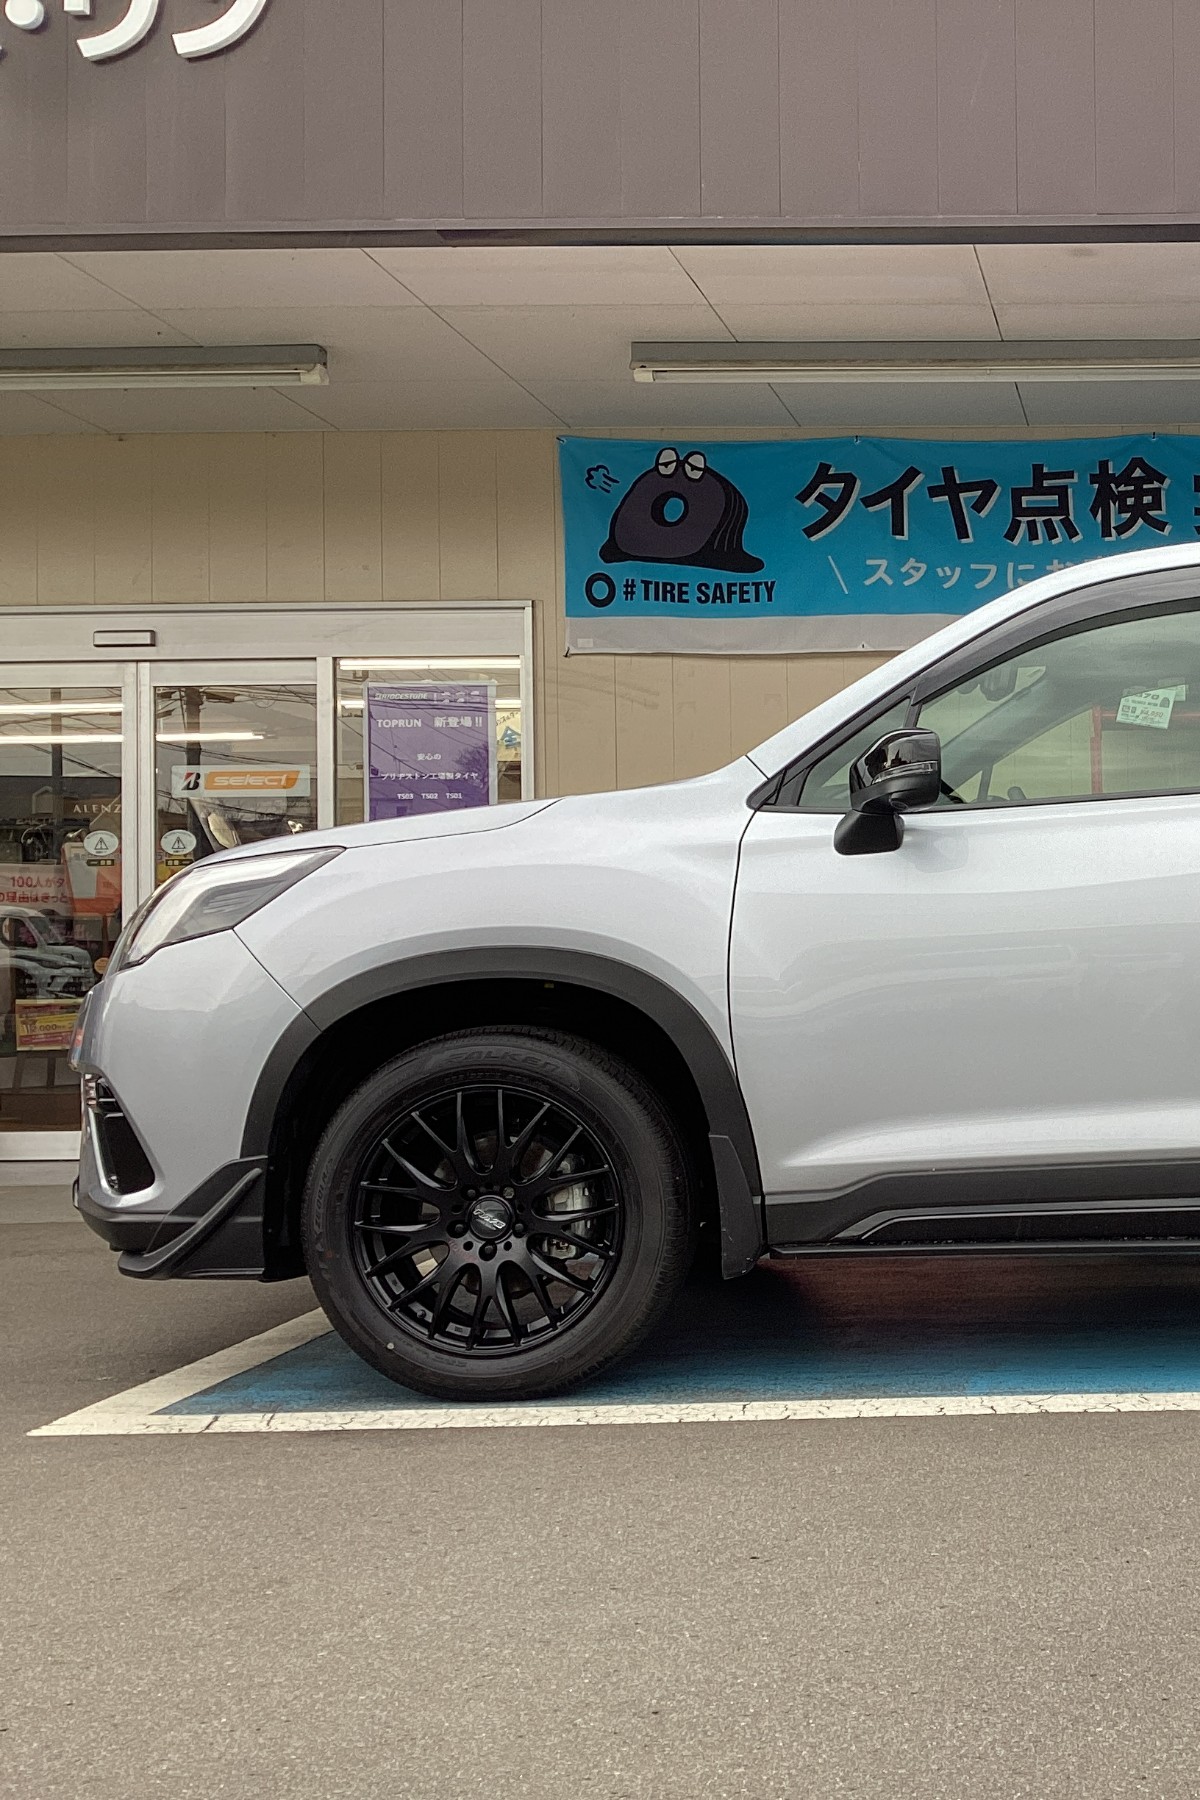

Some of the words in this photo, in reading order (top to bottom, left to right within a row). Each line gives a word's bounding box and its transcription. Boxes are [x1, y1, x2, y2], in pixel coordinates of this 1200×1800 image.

[795, 457, 1171, 544] タイヤ点検
[696, 580, 777, 605] SAFETY
[374, 692, 428, 701] BRIDGESTONE
[377, 719, 422, 728] TOPRUN
[416, 753, 442, 761] 安心の
[446, 792, 463, 800] TS01
[73, 804, 122, 814] ALENZ
[447, 1049, 562, 1073] FALKEN
